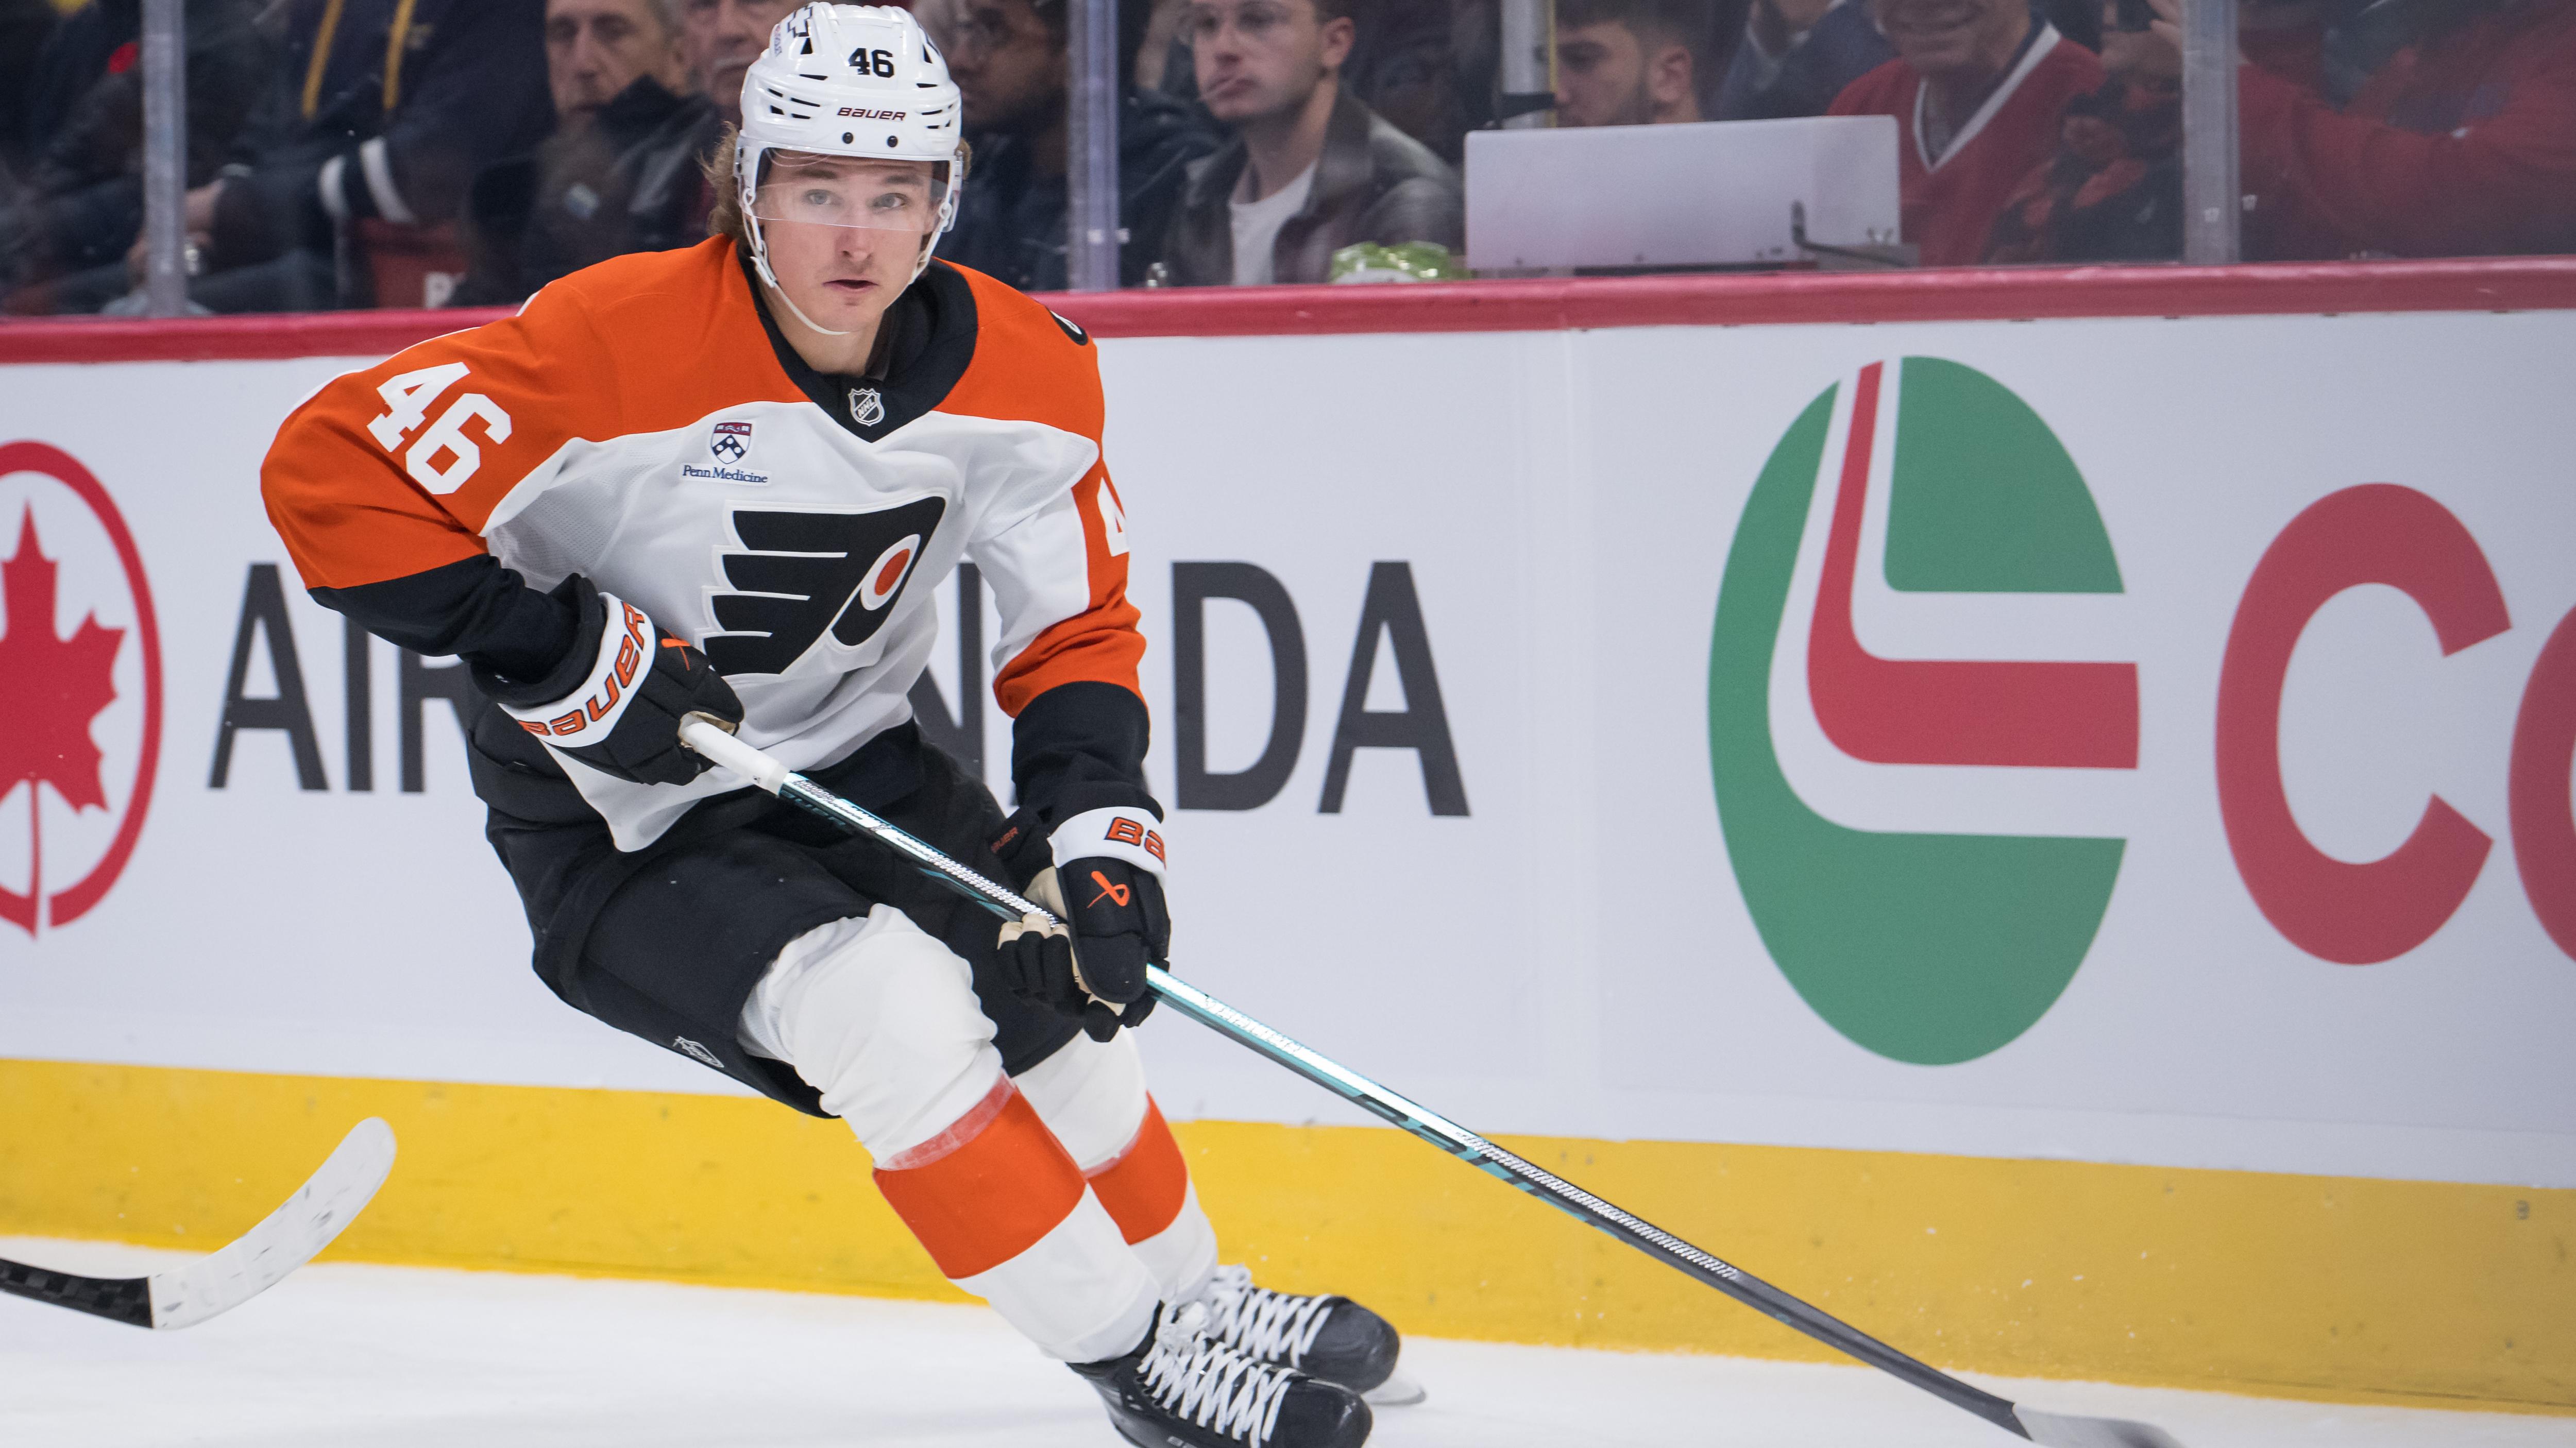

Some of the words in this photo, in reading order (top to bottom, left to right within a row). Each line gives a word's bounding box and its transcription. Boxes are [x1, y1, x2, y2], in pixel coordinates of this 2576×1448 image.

[848, 48, 894, 78] 46
[857, 399, 876, 417] NHL
[366, 362, 512, 495] 46
[683, 465, 710, 478] Penn
[713, 467, 768, 483] Medicine
